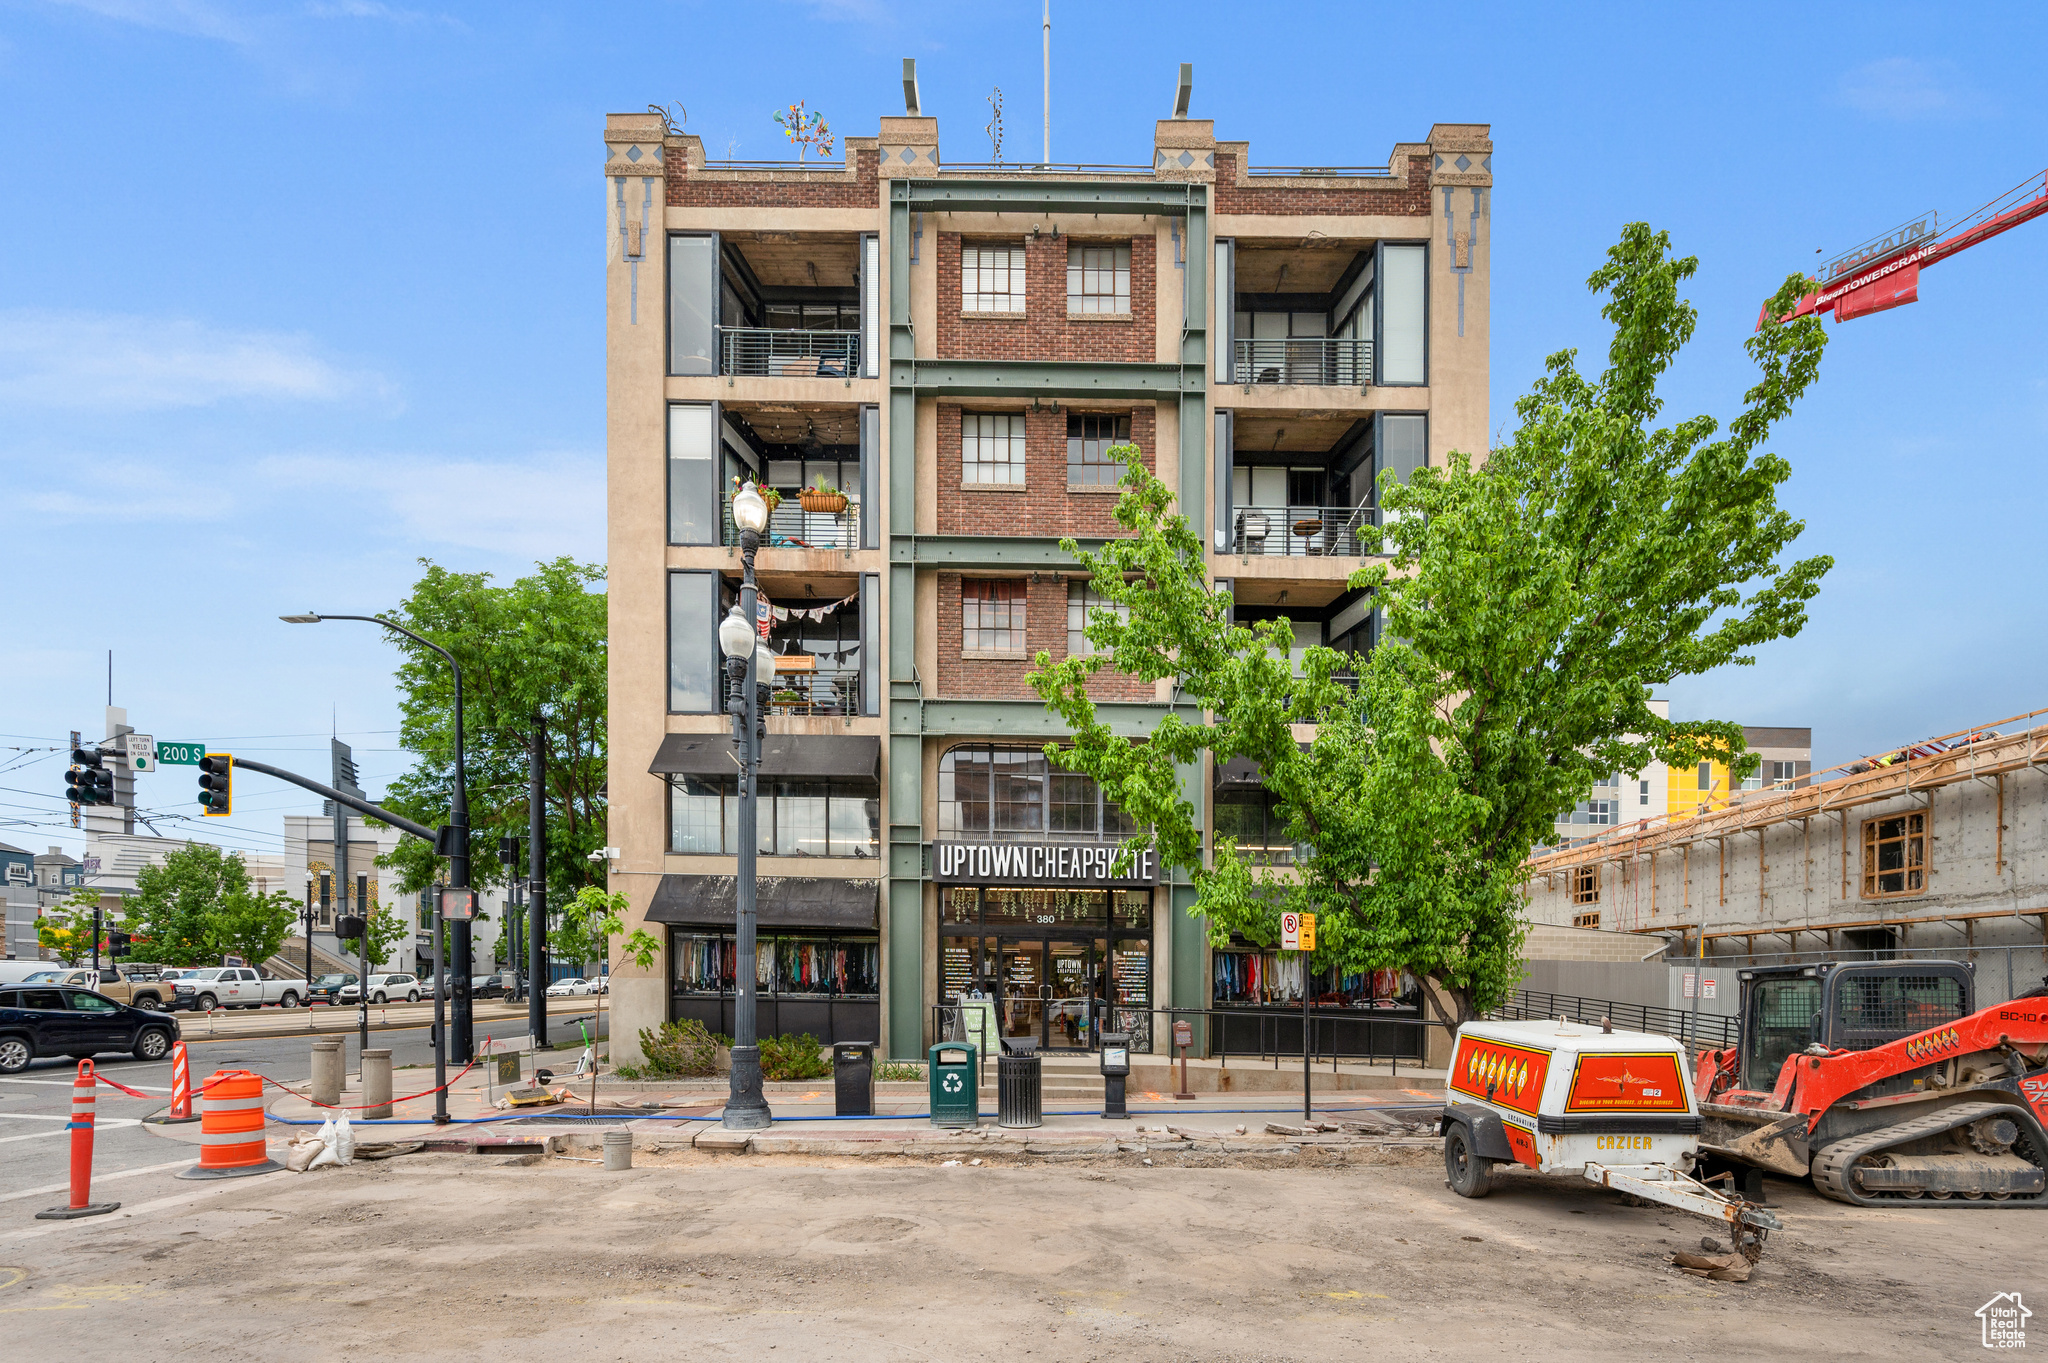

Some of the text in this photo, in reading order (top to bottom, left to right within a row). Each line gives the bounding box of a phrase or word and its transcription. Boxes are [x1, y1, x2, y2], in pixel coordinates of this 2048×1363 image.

[1828, 220, 1926, 280] POTAIN
[163, 746, 201, 761] 200 S
[940, 845, 1027, 877] UPTOWN
[465, 894, 472, 915] 2
[1036, 915, 1055, 924] 380
[1056, 959, 1081, 968] UPTOWN
[2000, 1011, 2037, 1022] BC-10
[1470, 1058, 1527, 1088] CAZIER
[1597, 1136, 1652, 1150] CAZIER
